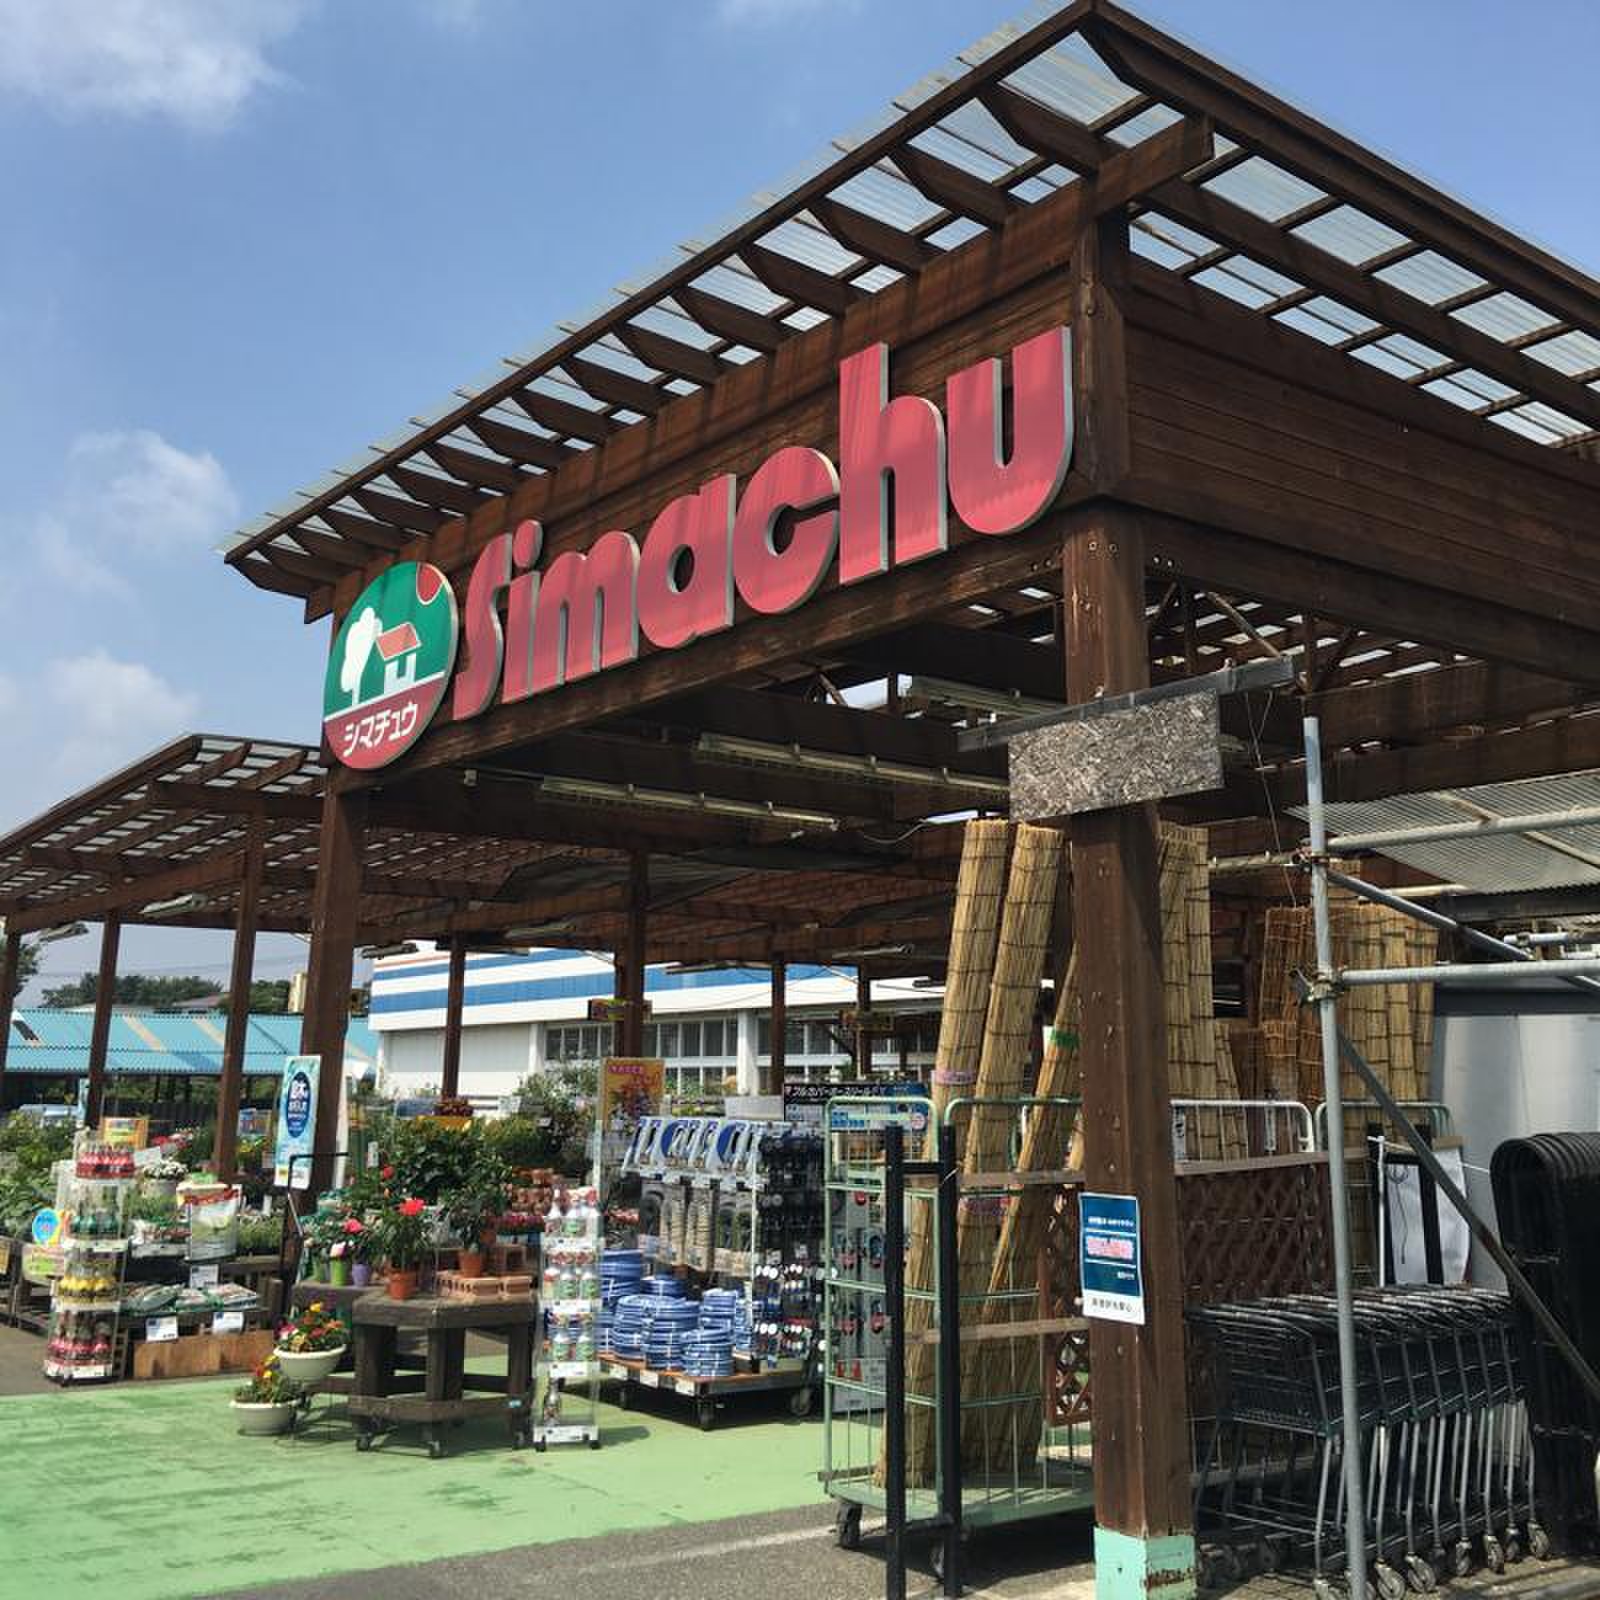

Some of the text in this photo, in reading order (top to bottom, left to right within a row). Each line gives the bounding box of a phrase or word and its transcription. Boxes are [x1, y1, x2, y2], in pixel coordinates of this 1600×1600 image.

[453, 326, 1074, 721] Simachu
[342, 701, 418, 757] シマチュウ
